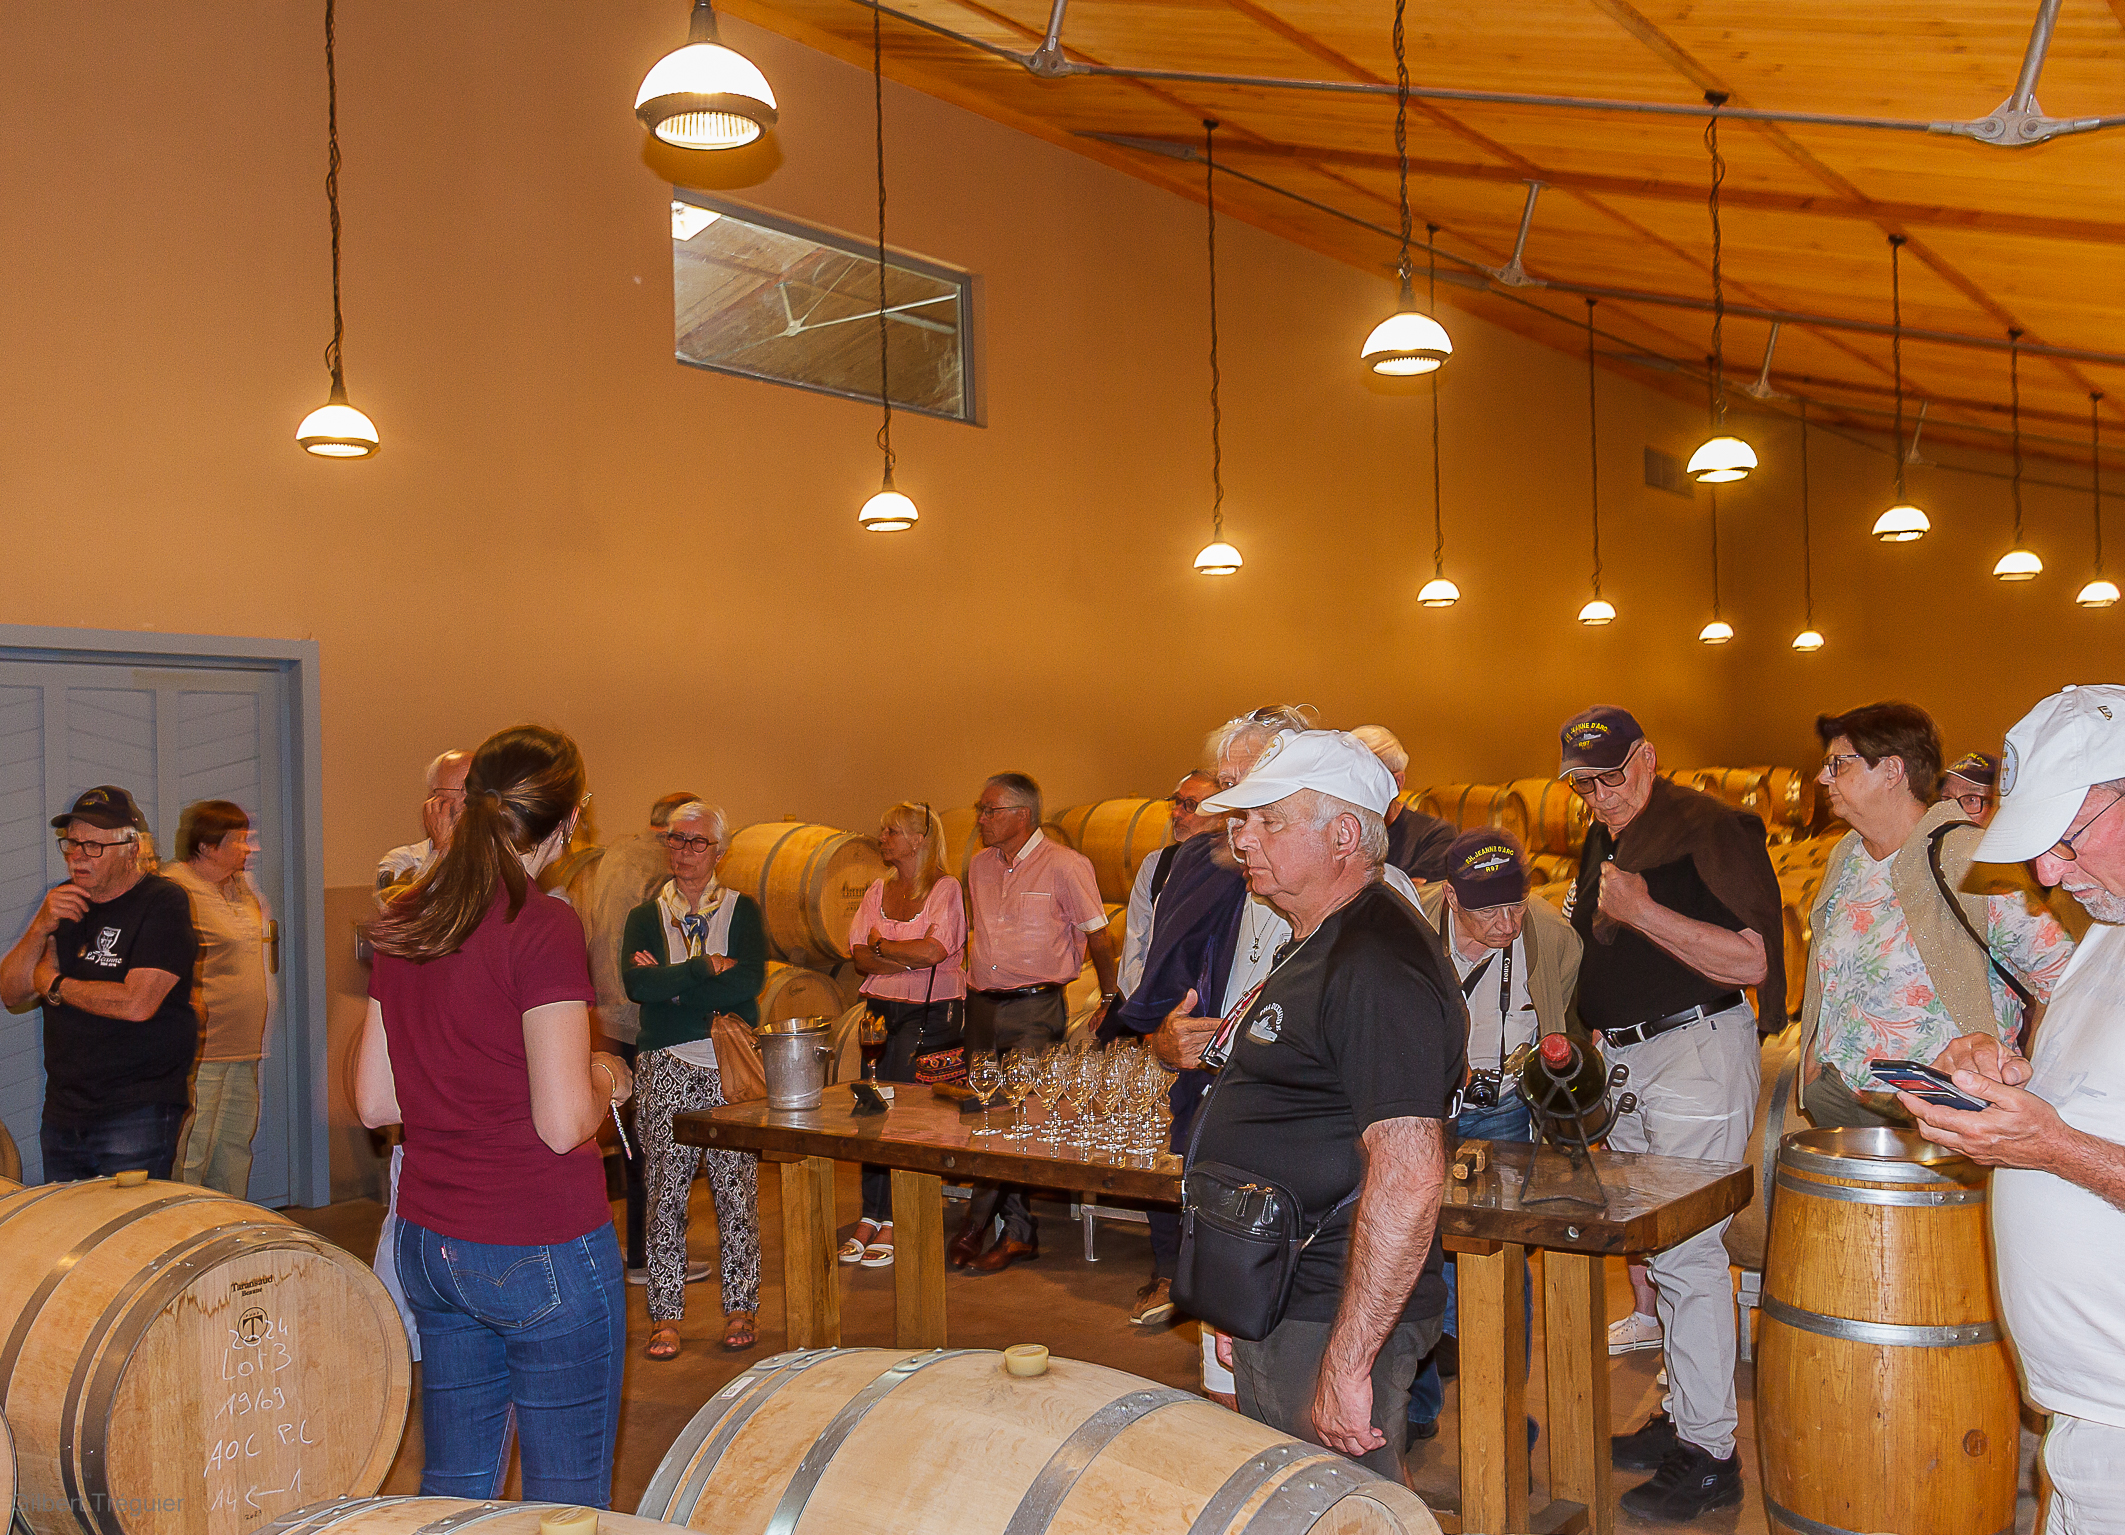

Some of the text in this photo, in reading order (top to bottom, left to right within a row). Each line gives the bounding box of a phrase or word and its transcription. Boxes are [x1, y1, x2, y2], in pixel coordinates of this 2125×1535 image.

[1503, 957, 1511, 983] Canon
[271, 1342, 292, 1373] 3
[215, 1387, 286, 1420] 19/09
[203, 1433, 261, 1478] AOC
